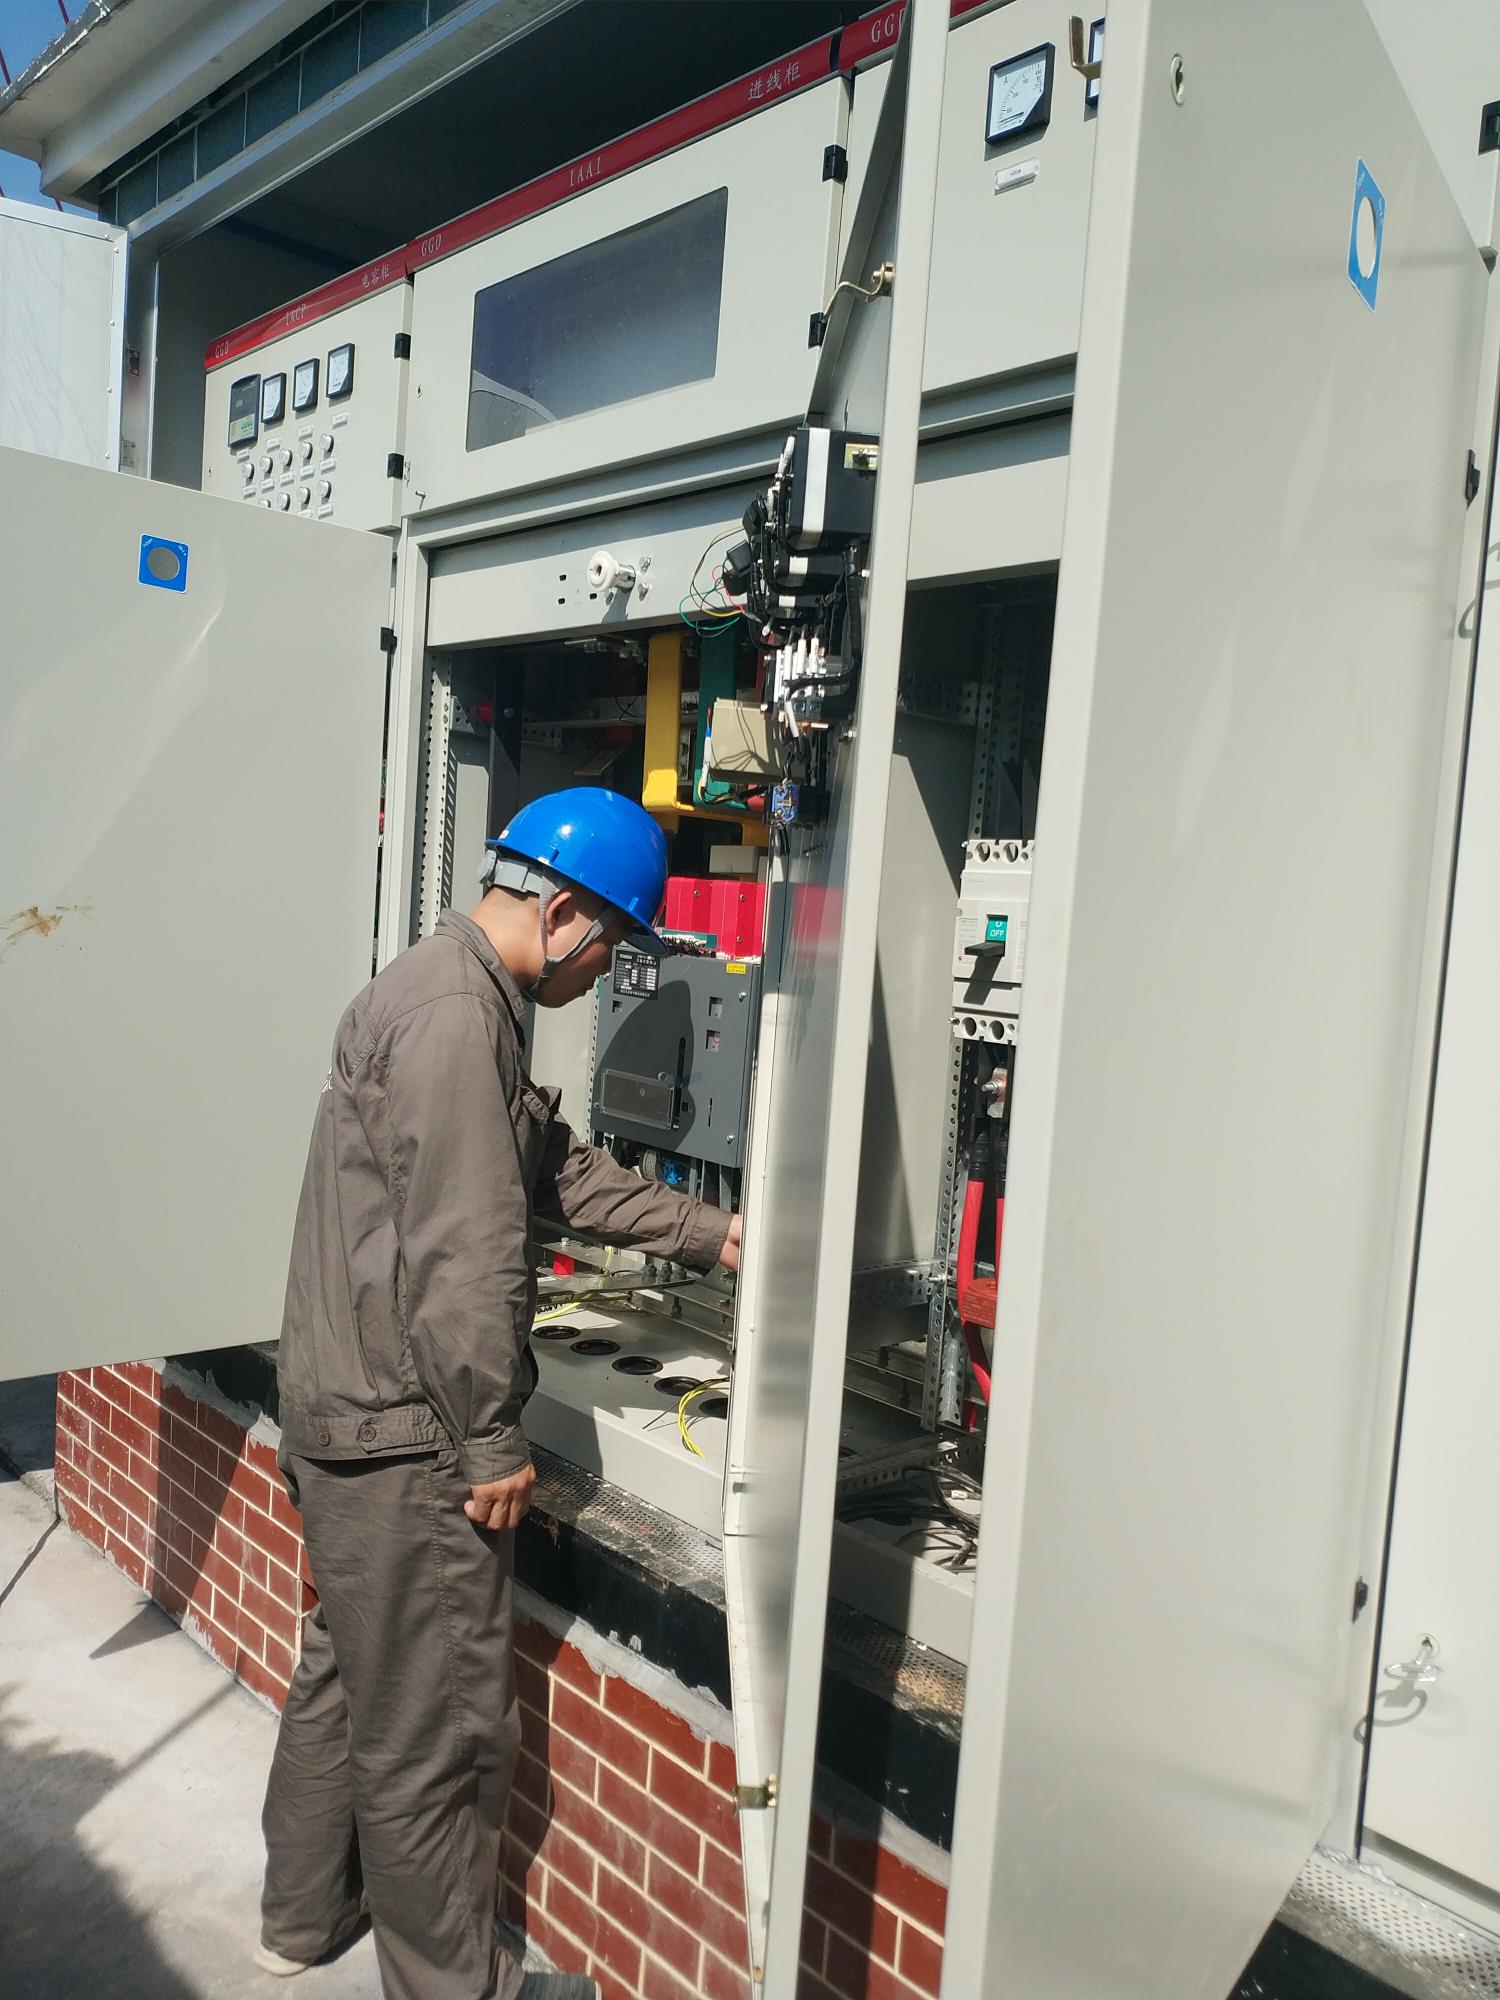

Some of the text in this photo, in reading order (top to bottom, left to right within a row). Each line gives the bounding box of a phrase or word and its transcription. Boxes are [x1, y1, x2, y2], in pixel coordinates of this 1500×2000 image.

[747, 61, 801, 101] 进线柜
[421, 233, 442, 257] GGD
[989, 929, 1005, 938] OFF
